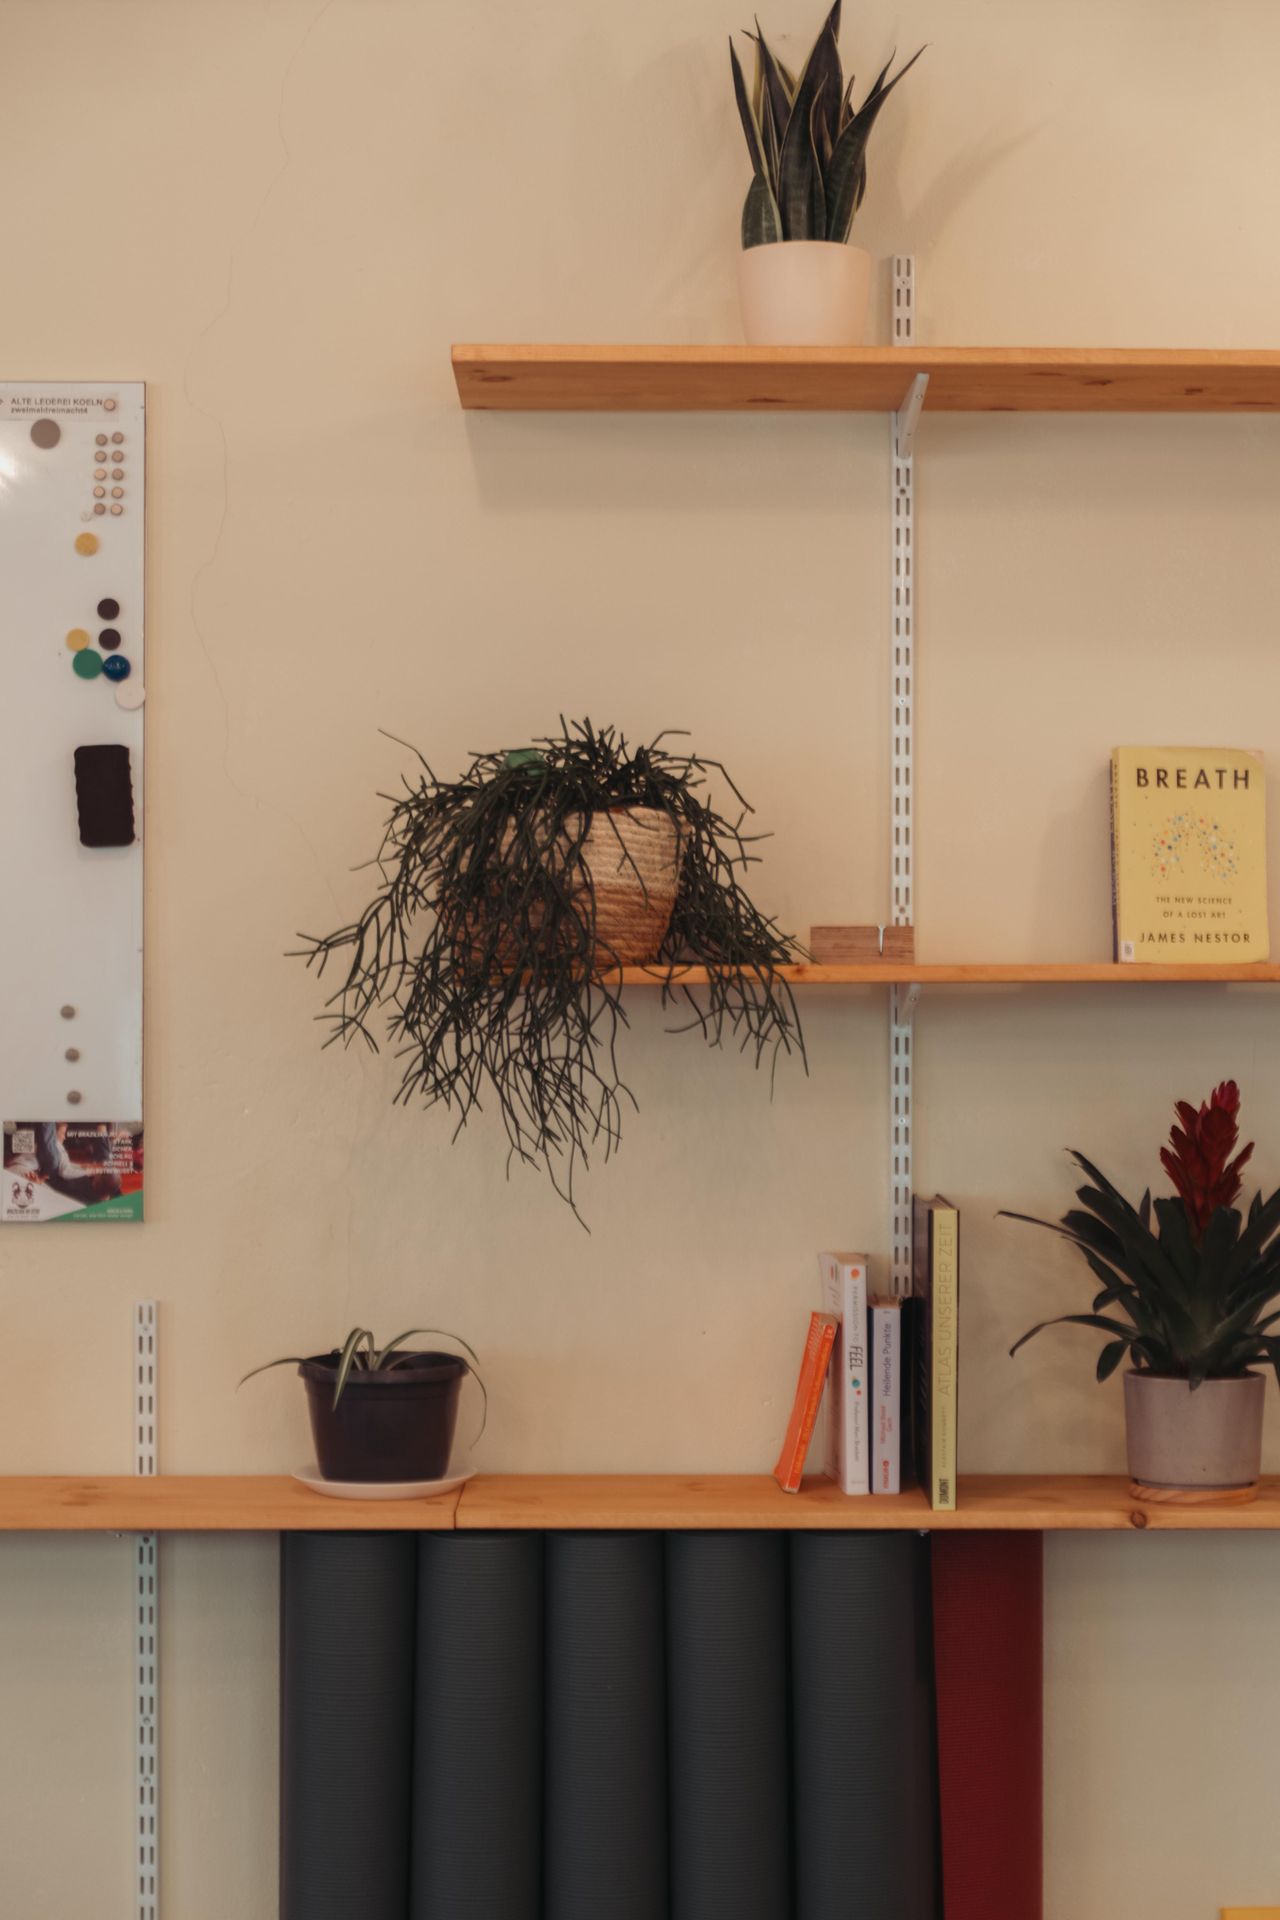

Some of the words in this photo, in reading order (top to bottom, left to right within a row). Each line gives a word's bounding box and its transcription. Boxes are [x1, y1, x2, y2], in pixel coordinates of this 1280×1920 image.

[35, 398, 70, 406] LEDEREI
[1136, 768, 1250, 790] BREATH
[1156, 896, 1170, 904] THE
[1174, 896, 1193, 904] NEW
[1198, 897, 1232, 905] SCIENCE
[1140, 933, 1185, 943] JAMES
[1194, 933, 1250, 944] NESTOR
[939, 1223, 952, 1257] ZEIT
[939, 1262, 952, 1340] UNSERER
[882, 1322, 892, 1355] Punkte
[849, 1345, 864, 1371] FEEL
[937, 1346, 951, 1397] ATLAS
[883, 1357, 892, 1397] Heilende
